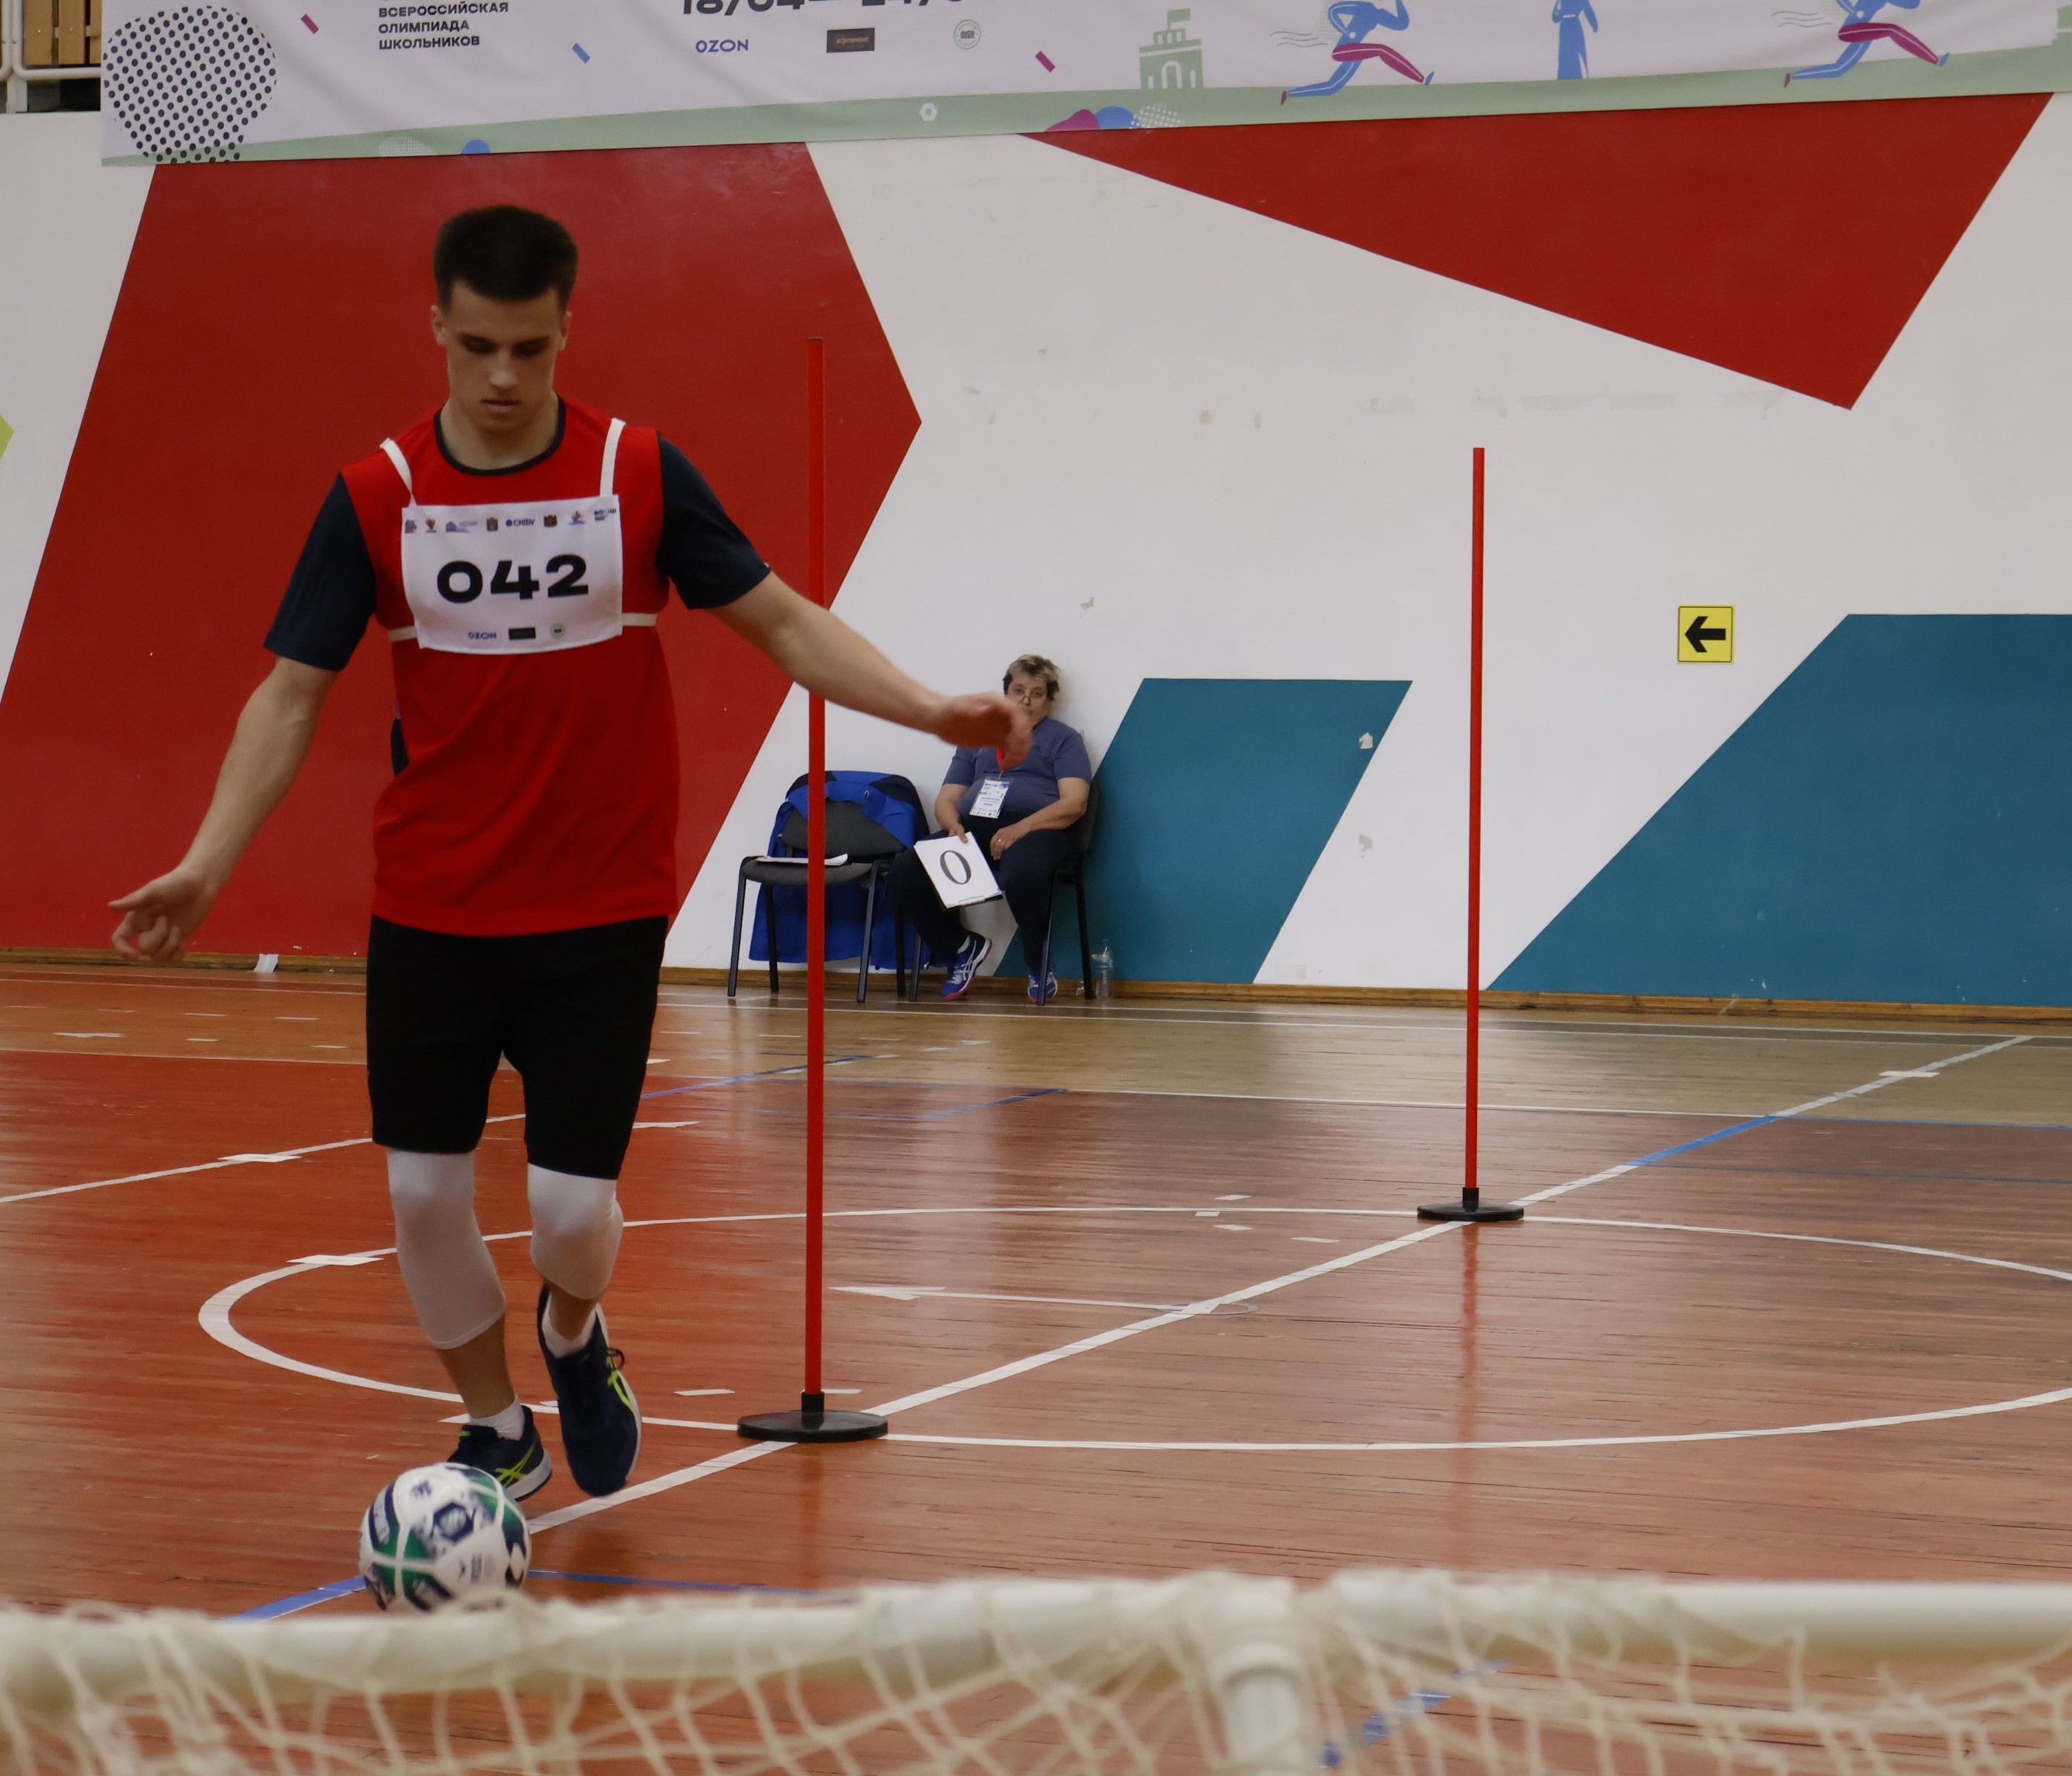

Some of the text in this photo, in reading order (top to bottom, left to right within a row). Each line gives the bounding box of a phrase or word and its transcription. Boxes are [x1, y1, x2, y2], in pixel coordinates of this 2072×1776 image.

[379, 1, 508, 18] ВСЕРОССИЙСКАЯ
[378, 20, 470, 34] ОЛИМПИАДА
[379, 36, 480, 50] ШКОЛЬНИКОВ
[696, 38, 749, 53] OZON
[437, 554, 589, 604] 042
[468, 632, 497, 640] OZON
